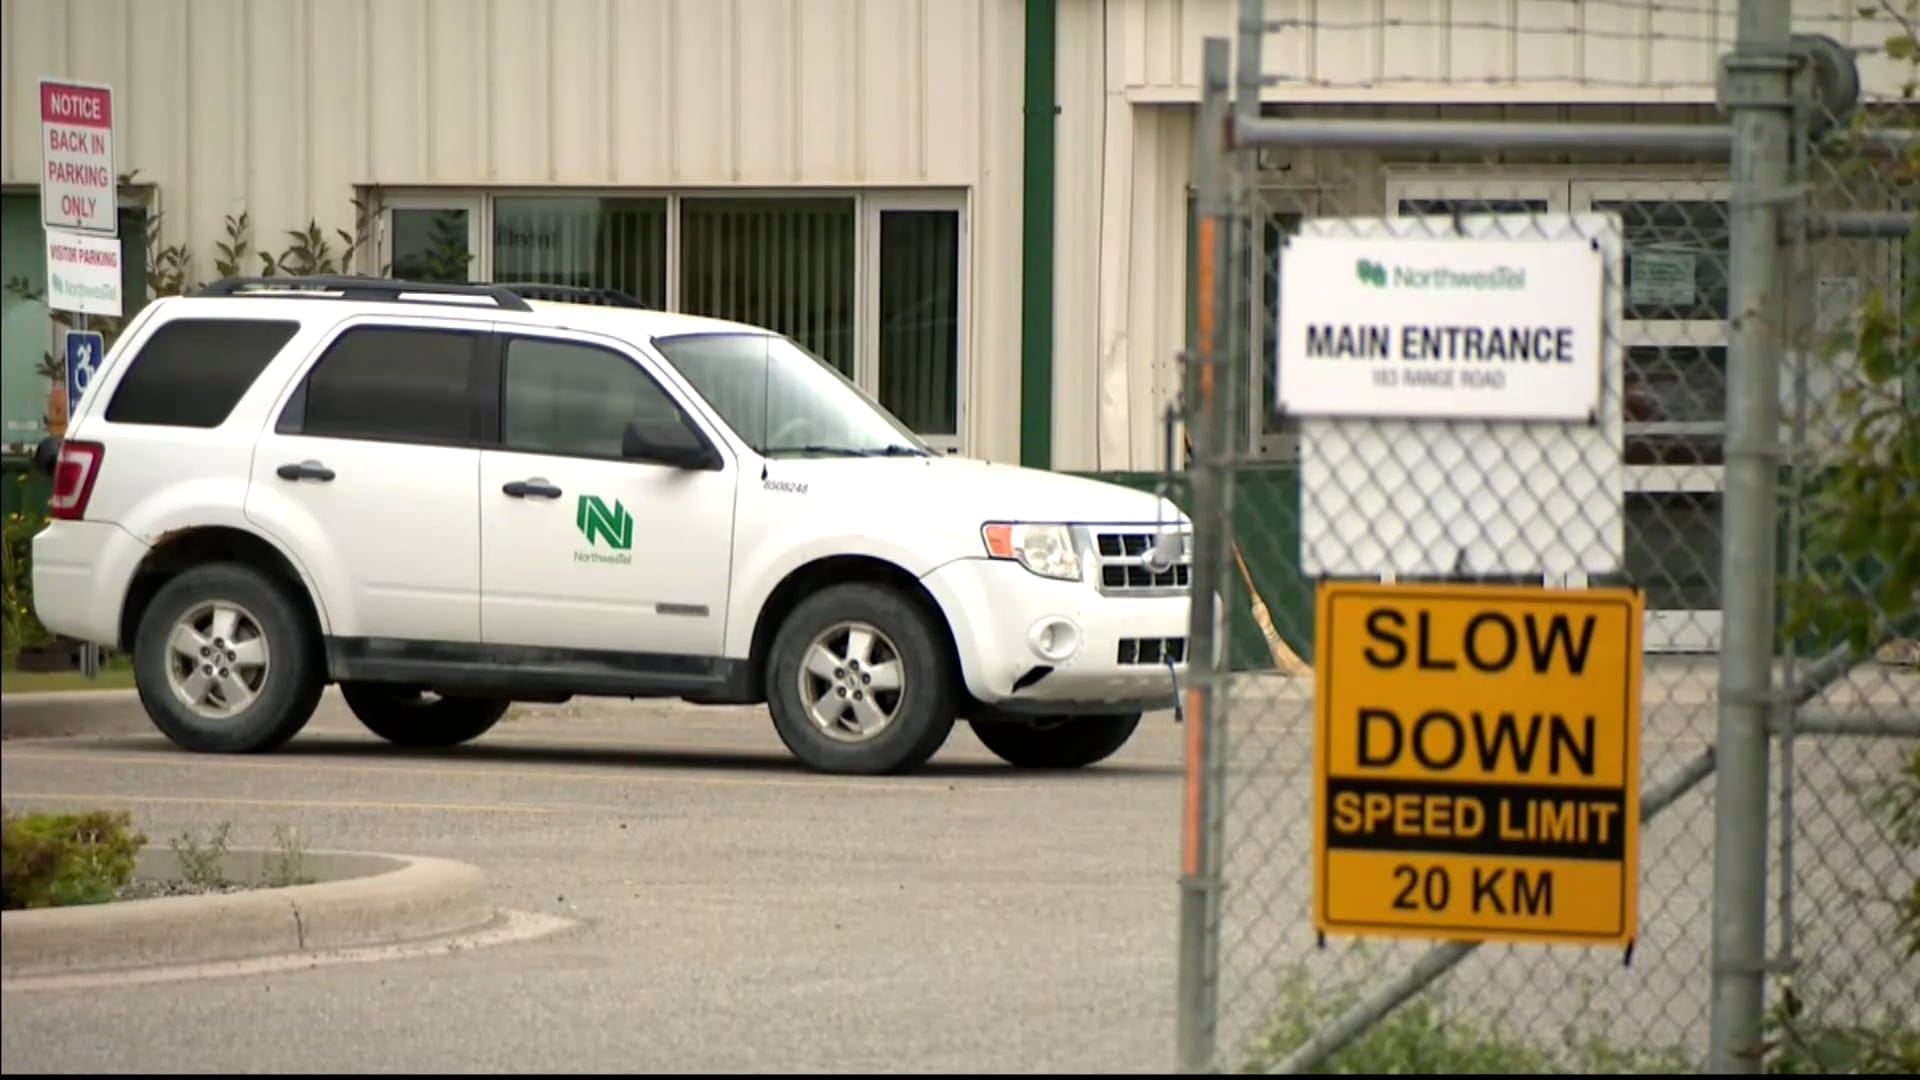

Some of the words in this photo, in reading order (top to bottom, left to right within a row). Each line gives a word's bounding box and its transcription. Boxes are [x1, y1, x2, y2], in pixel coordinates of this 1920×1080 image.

[51, 94, 101, 119] NOTICE
[50, 128, 87, 152] BACK
[91, 134, 105, 156] IN
[48, 164, 108, 188] PARKING
[62, 195, 96, 218] ONLY
[50, 244, 77, 262] VISITOR
[79, 248, 117, 268] PARKING
[1306, 325, 1389, 358] MAIN
[1402, 326, 1573, 362] ENTRANCE
[1403, 370, 1454, 388] RANGE
[1461, 371, 1505, 389] ROAD
[1363, 607, 1596, 675] SLOW
[1357, 708, 1595, 775] DOWN
[1333, 792, 1485, 838] SPEED
[1499, 799, 1617, 843] LIMIT
[1392, 864, 1450, 910] 20
[1472, 867, 1553, 915] KM
